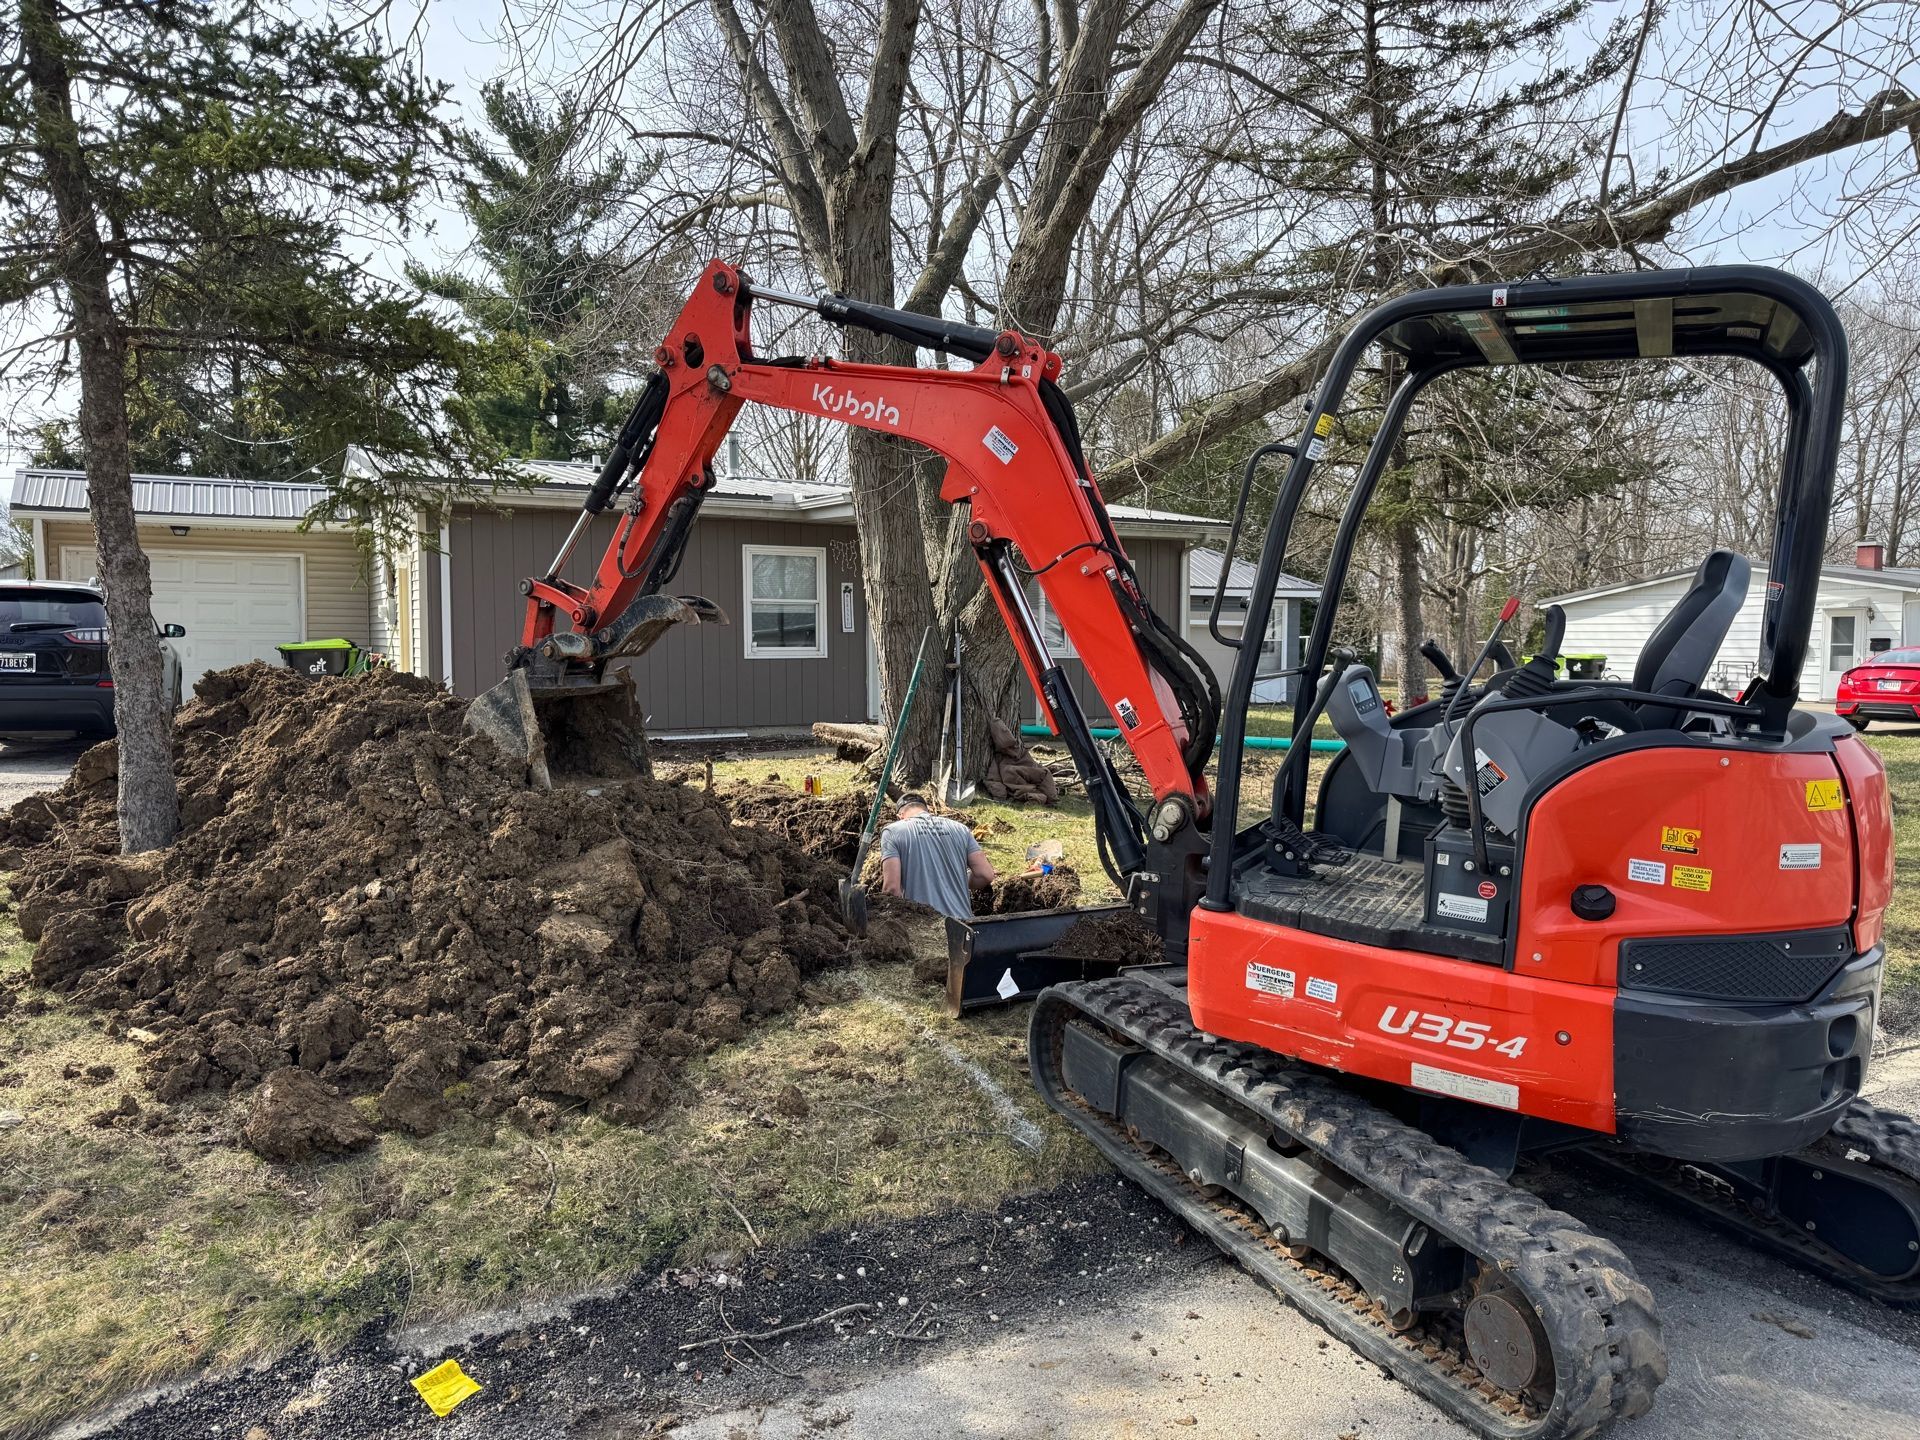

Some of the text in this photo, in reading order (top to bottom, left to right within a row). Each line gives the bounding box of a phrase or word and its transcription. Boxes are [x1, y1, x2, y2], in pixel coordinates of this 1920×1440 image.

[812, 383, 899, 426] Kubota
[0, 658, 28, 668] 718EYS
[310, 661, 327, 672] GFL
[1253, 965, 1291, 978] JUERGENS
[1378, 1006, 1528, 1058] U35-4
